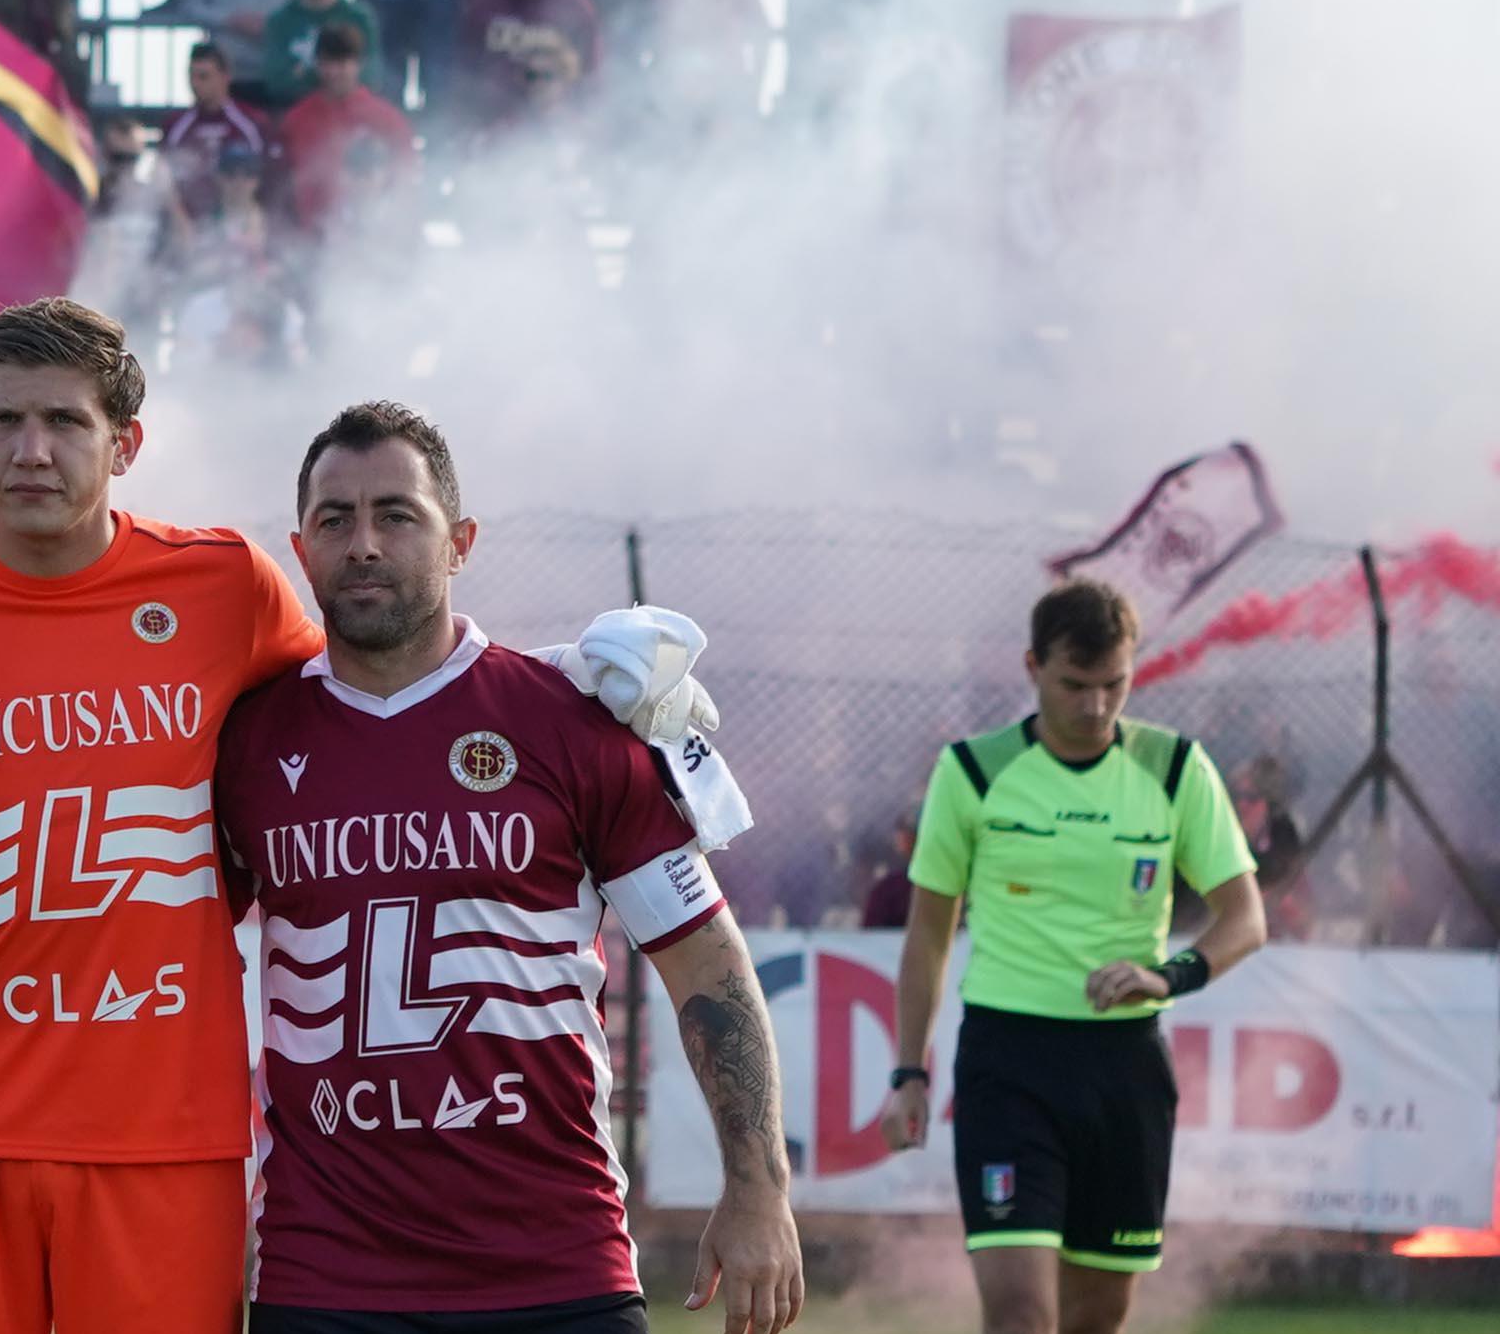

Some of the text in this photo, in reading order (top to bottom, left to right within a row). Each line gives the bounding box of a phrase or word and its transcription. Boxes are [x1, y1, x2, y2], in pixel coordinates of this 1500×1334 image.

[263, 810, 536, 888] UNICUSANO
[3, 962, 185, 1024] CLAS
[345, 1072, 529, 1132] CLAS
